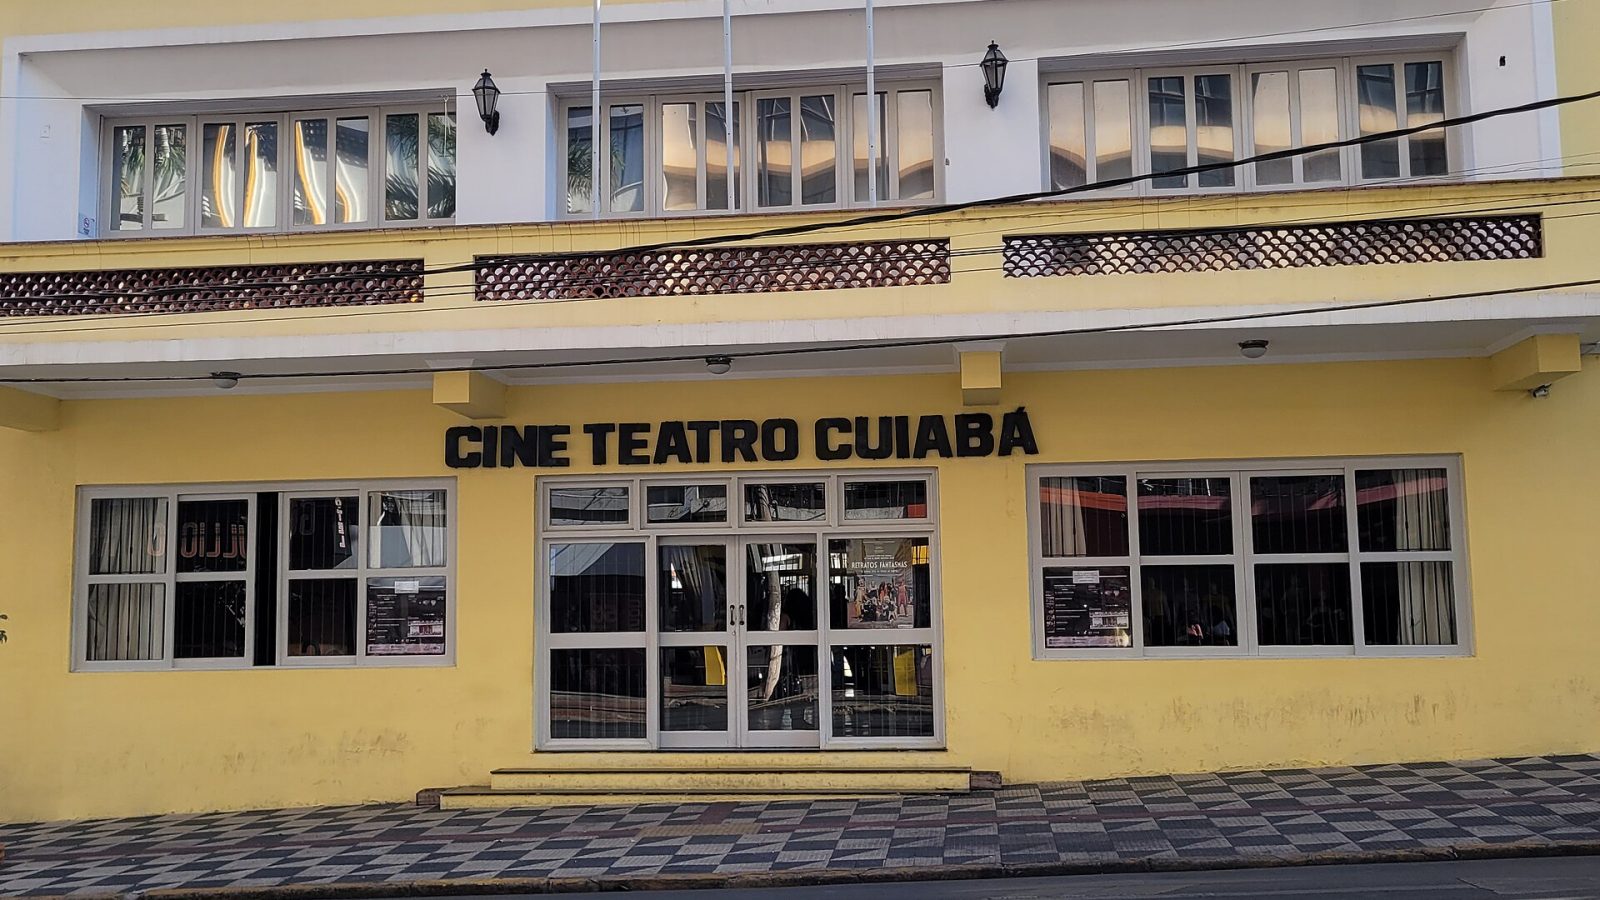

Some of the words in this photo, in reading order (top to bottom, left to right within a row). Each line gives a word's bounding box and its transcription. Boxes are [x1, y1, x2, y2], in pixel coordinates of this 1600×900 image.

[445, 425, 571, 468] CINE
[583, 418, 799, 466] TEATRO
[815, 406, 1040, 461] CUIABÁ
[851, 561, 878, 569] RETRATOS
[879, 560, 908, 568] FANTASMAS
